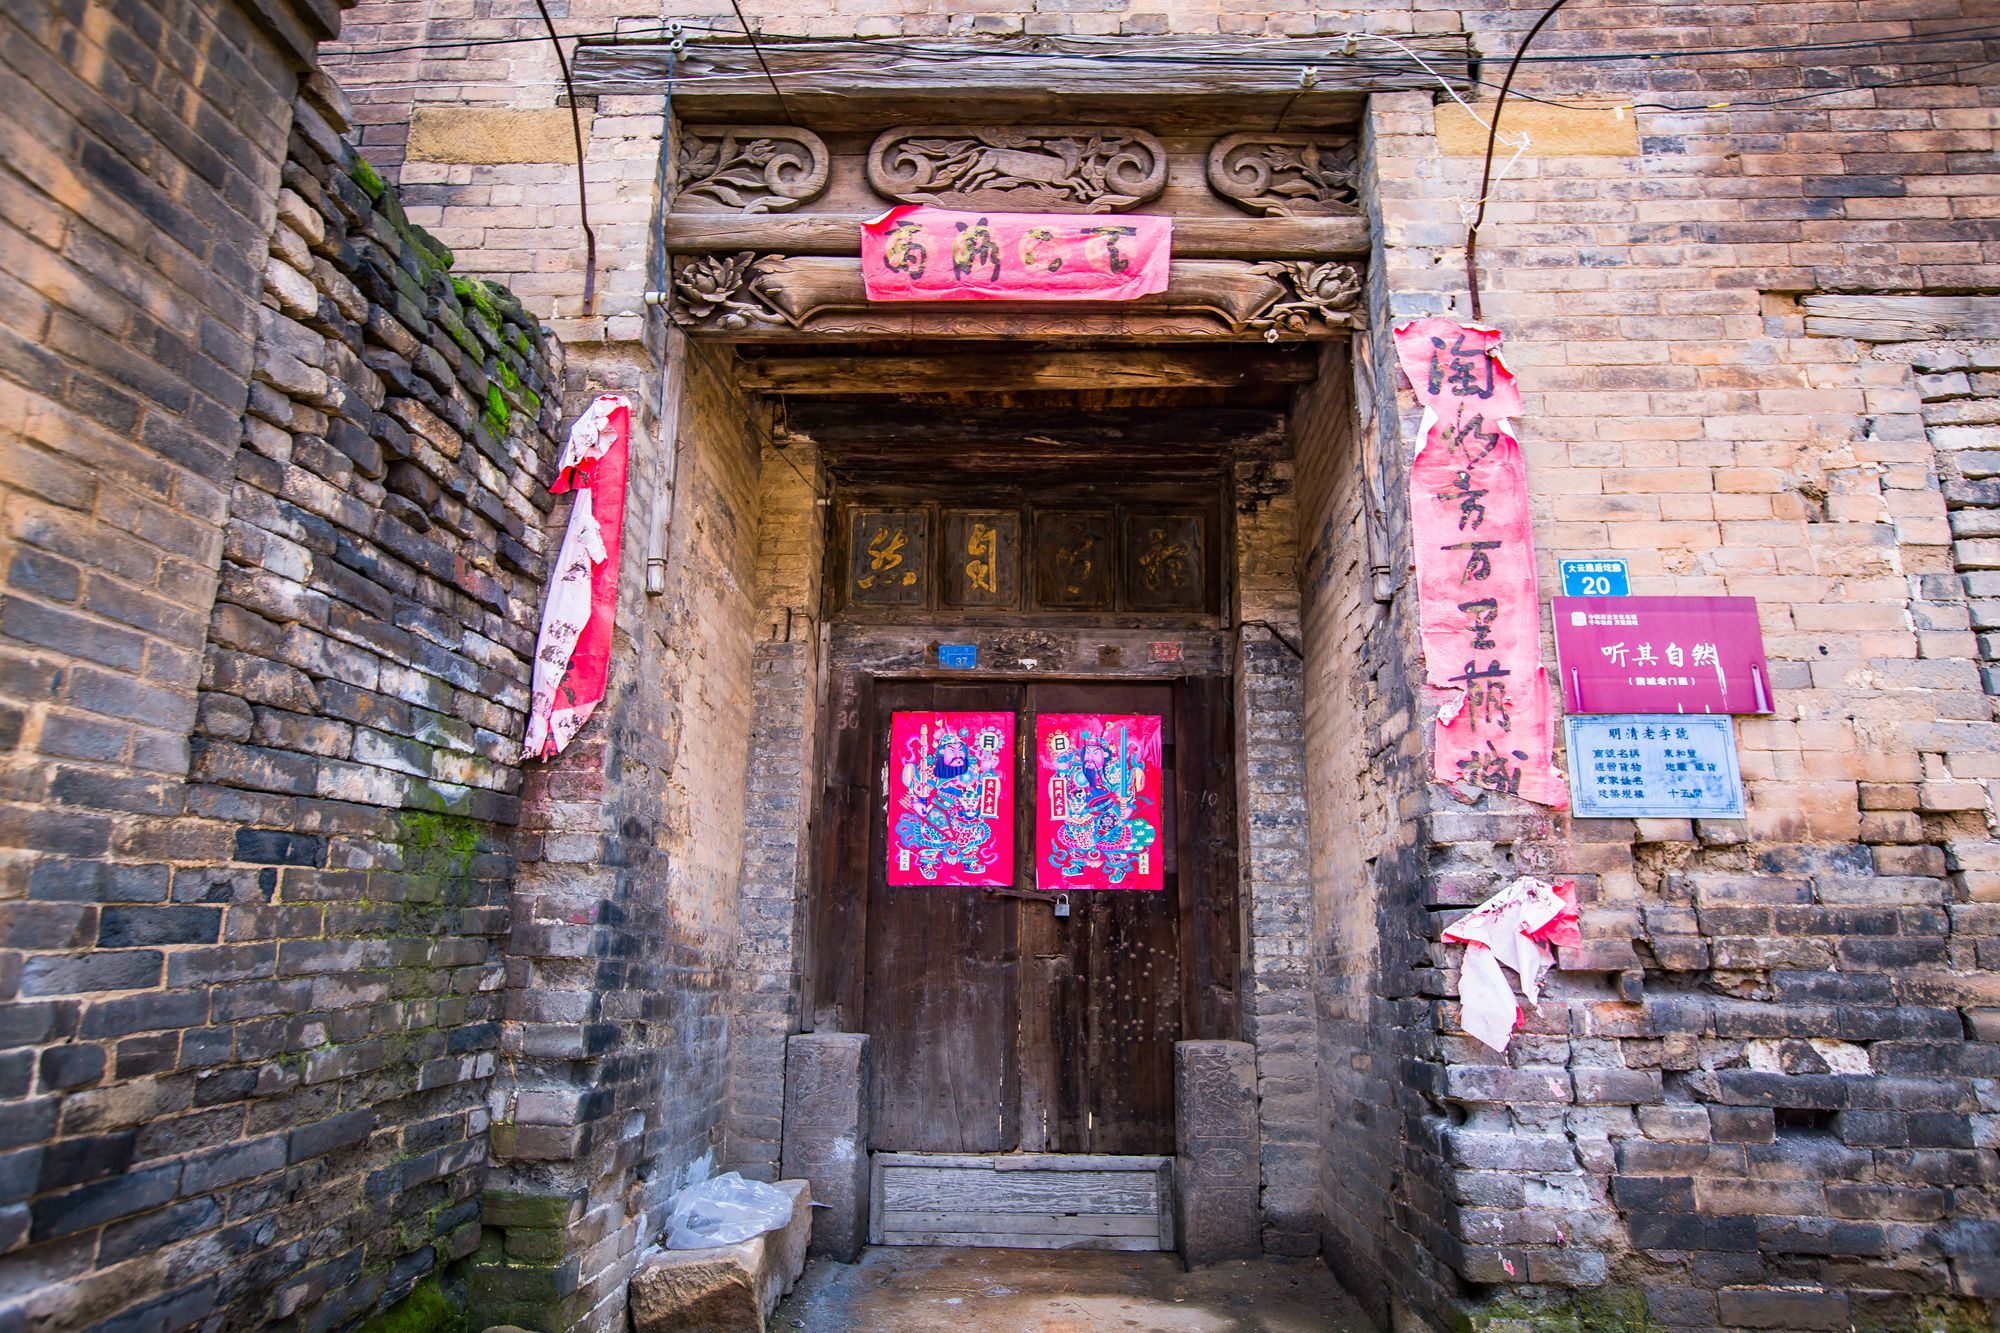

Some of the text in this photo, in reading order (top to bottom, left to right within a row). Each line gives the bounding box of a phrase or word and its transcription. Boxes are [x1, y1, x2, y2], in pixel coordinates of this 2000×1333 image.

[1581, 576, 1611, 595] 20
[1600, 641, 1716, 668] 听其自然
[982, 734, 997, 749] 月
[1054, 735, 1066, 750] 日
